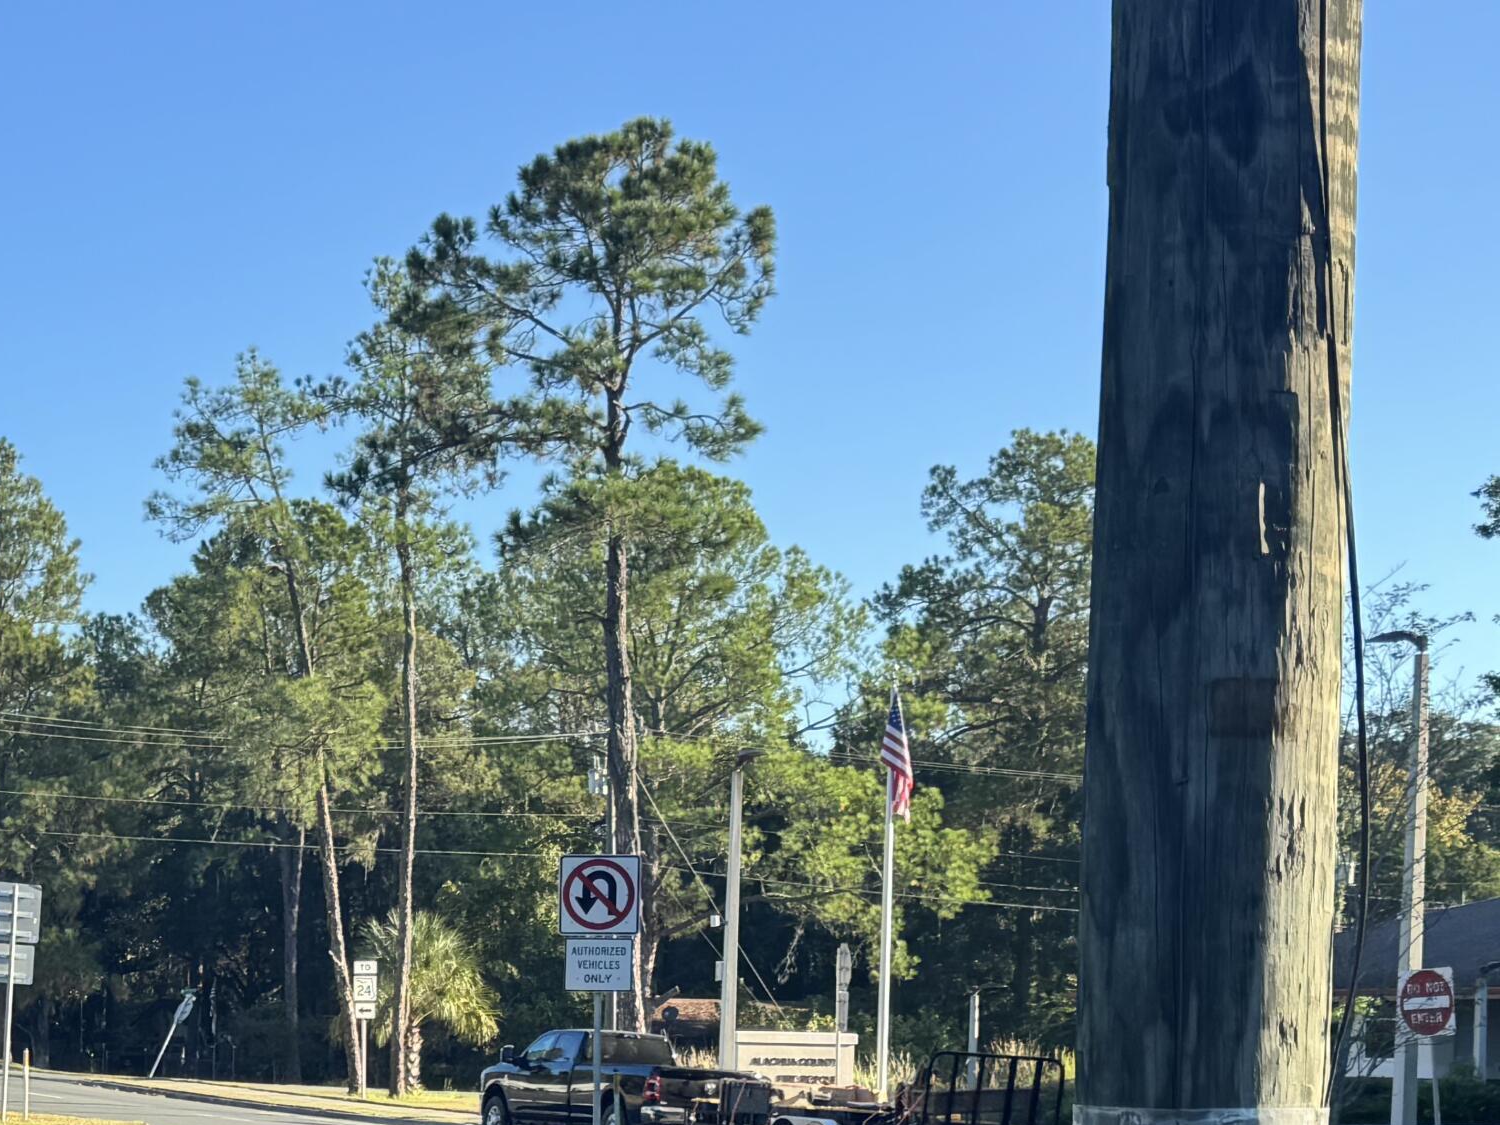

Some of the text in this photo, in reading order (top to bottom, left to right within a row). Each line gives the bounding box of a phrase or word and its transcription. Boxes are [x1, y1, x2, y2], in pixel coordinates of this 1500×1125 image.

[572, 946, 627, 956] AUTHORIZED
[577, 960, 620, 970] VEHICLES
[584, 974, 612, 983] ONLY
[357, 984, 371, 996] 24
[1407, 982, 1444, 993] DO NOT
[1411, 1012, 1442, 1024] ENTER
[749, 1057, 797, 1067] ALACHUA
